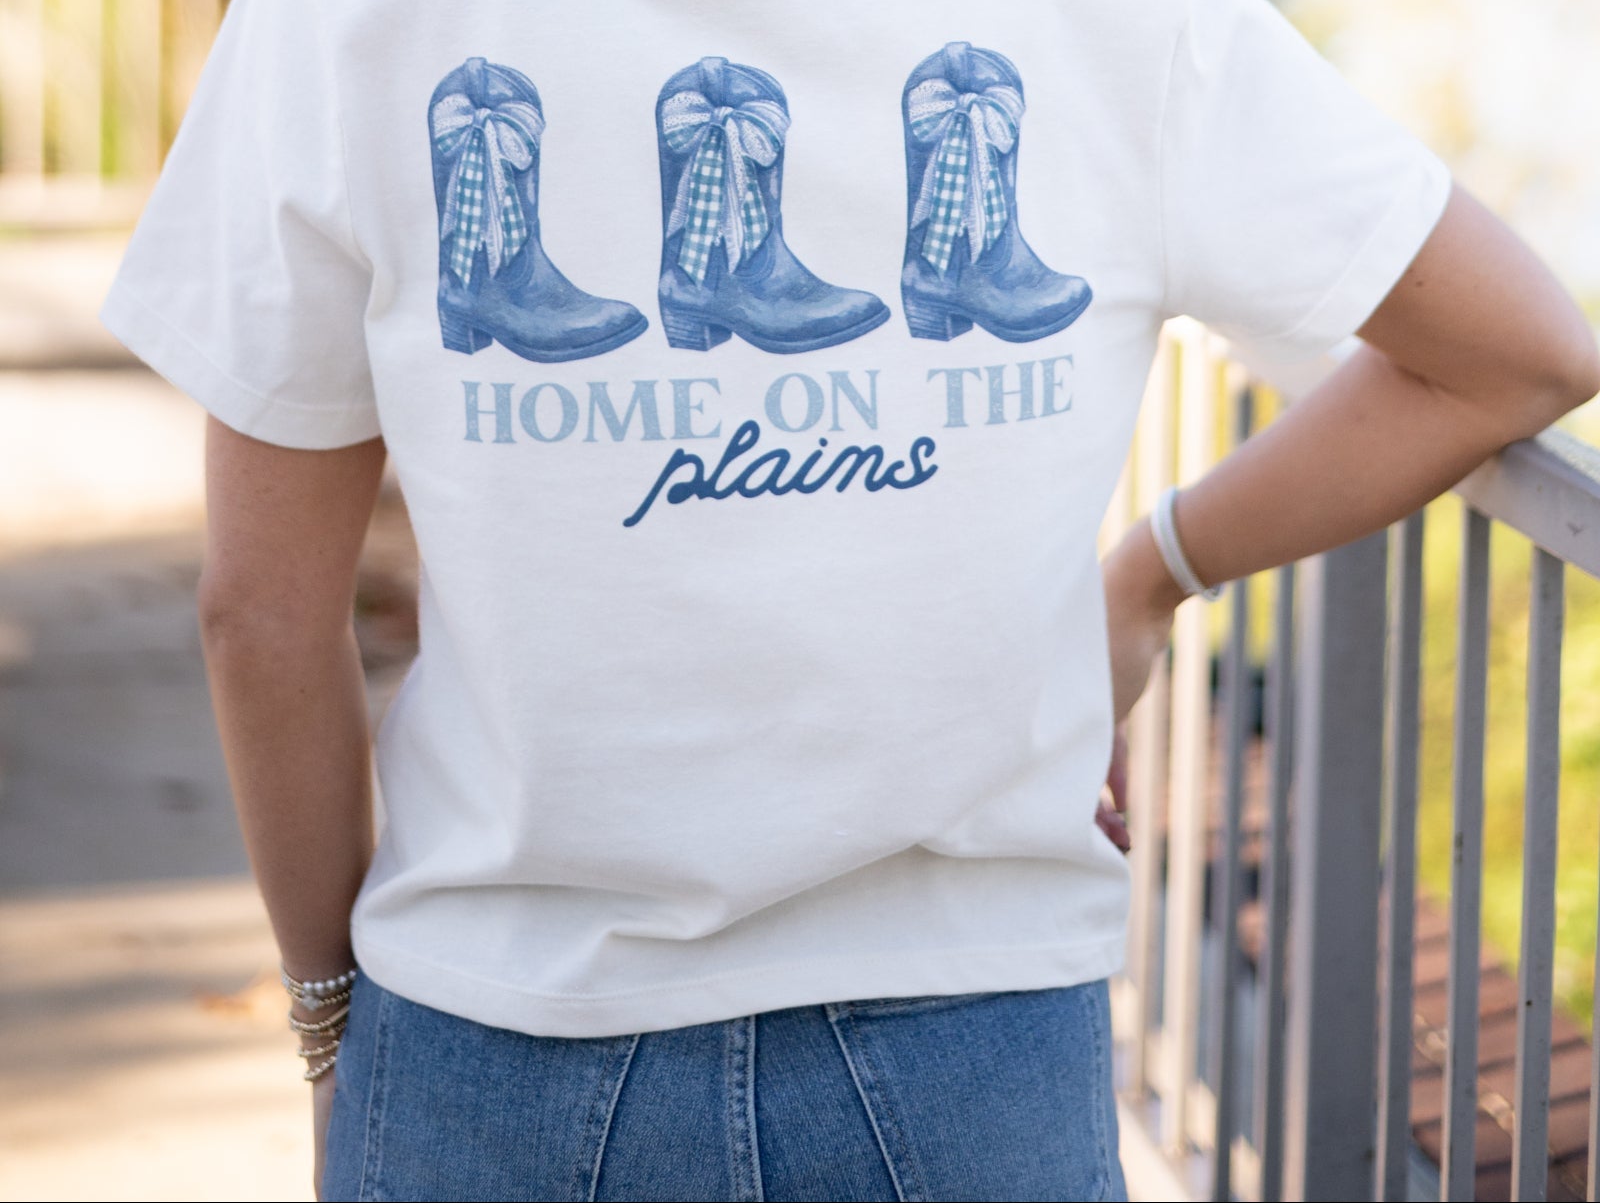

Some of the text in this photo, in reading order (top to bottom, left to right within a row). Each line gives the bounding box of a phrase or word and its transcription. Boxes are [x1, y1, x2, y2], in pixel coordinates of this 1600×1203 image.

[460, 353, 1075, 445] HOME ON THE
[622, 419, 939, 528] plains
